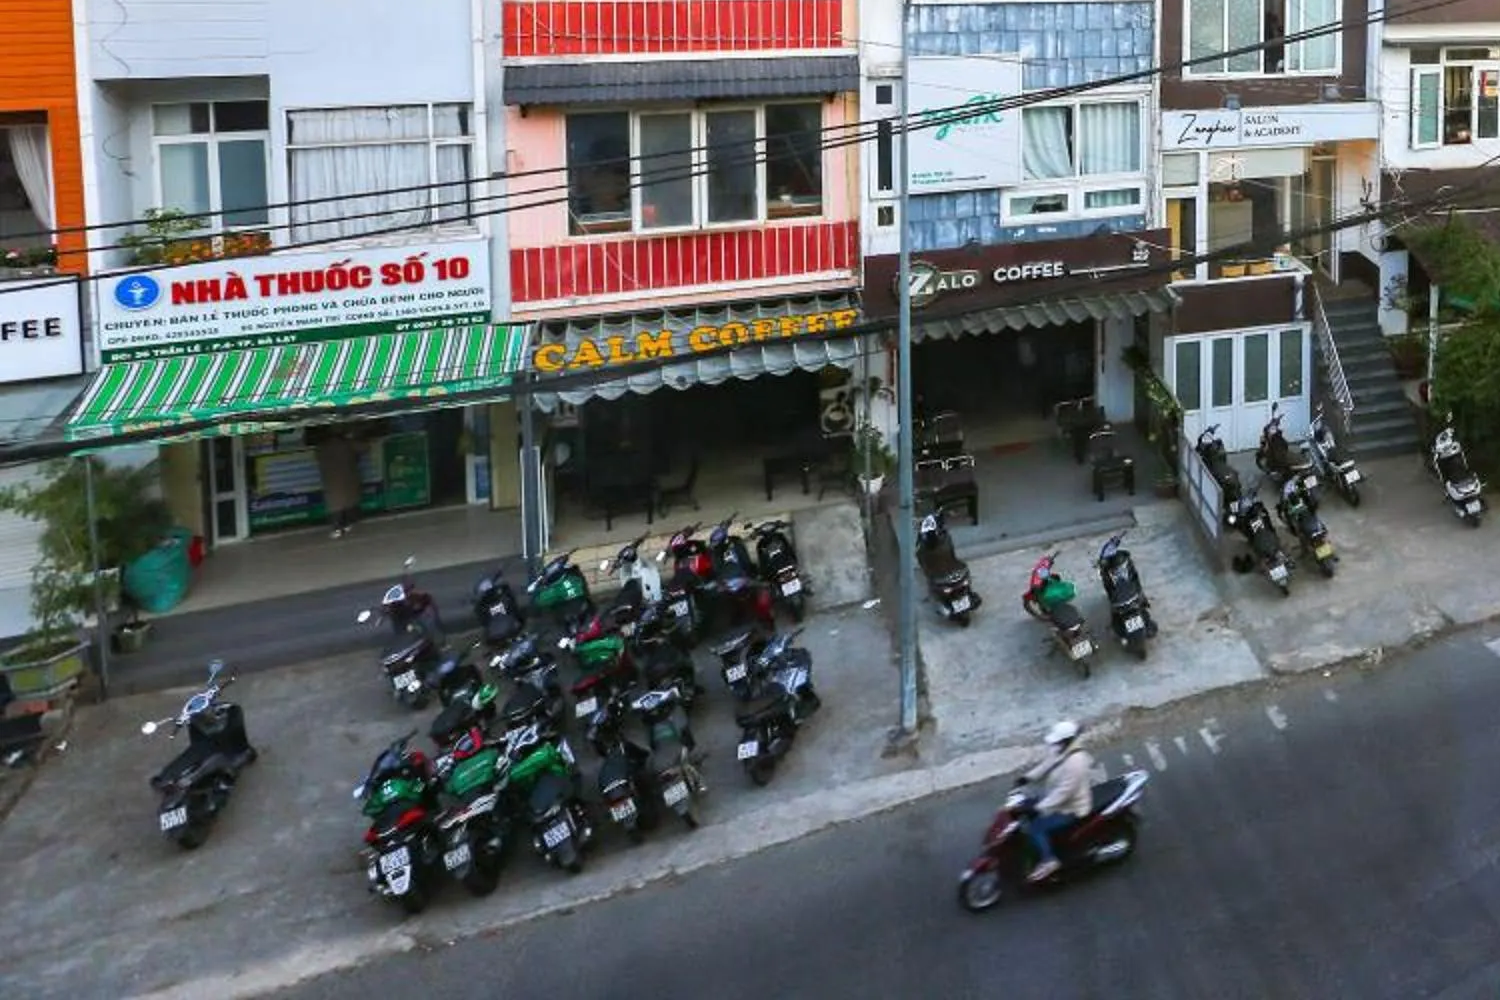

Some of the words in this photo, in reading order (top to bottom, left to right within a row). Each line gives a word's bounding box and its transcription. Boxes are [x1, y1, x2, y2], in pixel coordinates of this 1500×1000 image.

[171, 271, 249, 305] NHÀ
[253, 257, 372, 297] THUỐC
[380, 251, 428, 286] SỐ
[432, 256, 470, 281] 10
[908, 272, 977, 296] ZALO
[993, 260, 1065, 282] COFFEE
[0, 317, 61, 341] FEE
[531, 329, 673, 372] CALM
[687, 308, 858, 353] COFFEE
